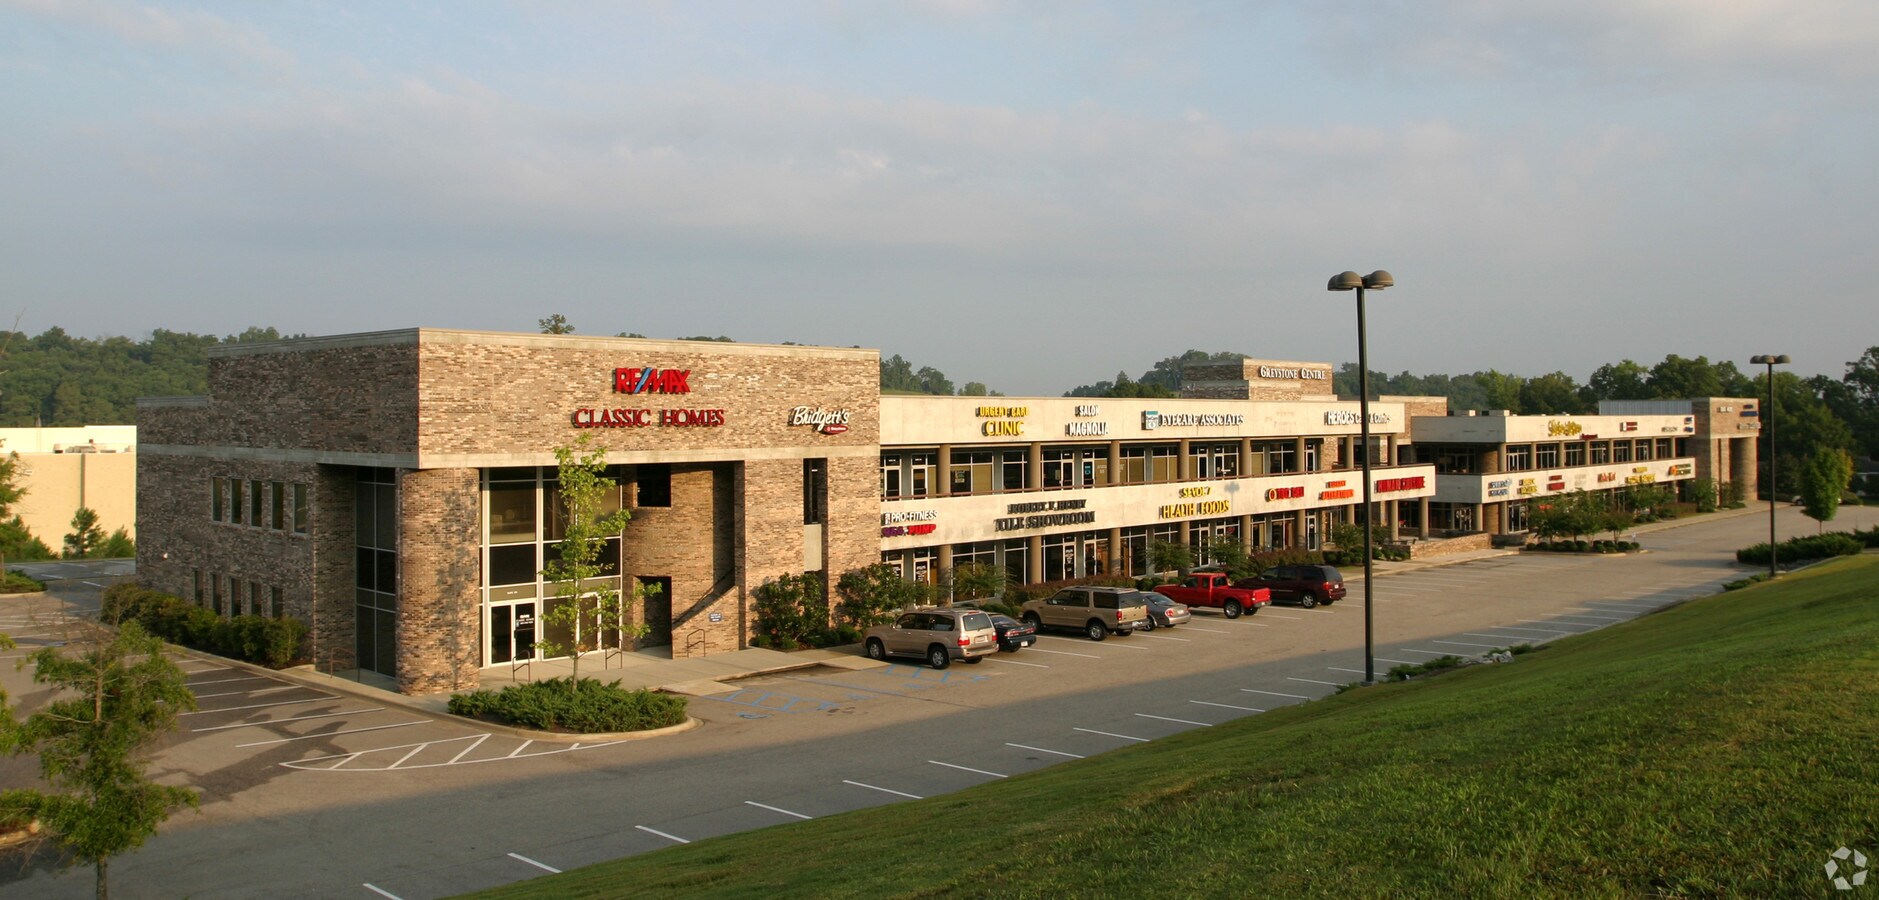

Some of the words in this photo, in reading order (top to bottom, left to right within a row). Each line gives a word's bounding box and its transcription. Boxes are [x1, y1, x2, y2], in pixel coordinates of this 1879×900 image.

[1259, 365, 1298, 379] GREYSTONE
[1300, 367, 1326, 380] CENTRE
[573, 408, 651, 427] CLASSIC
[661, 408, 724, 426] HOMES
[792, 405, 850, 431] Bridgett's
[978, 406, 1006, 417] URGENT
[1078, 405, 1100, 417] SALON
[1327, 410, 1355, 425] HEROES
[1161, 413, 1197, 426] EYECARE
[1199, 413, 1244, 426] ASSOCIATES
[984, 420, 1024, 436] CLINIC
[1068, 421, 1109, 436] MAGNOLIA
[1162, 503, 1195, 518] HEALTH
[1202, 500, 1230, 515] FOODS
[1026, 511, 1095, 528] SHOWROOM
